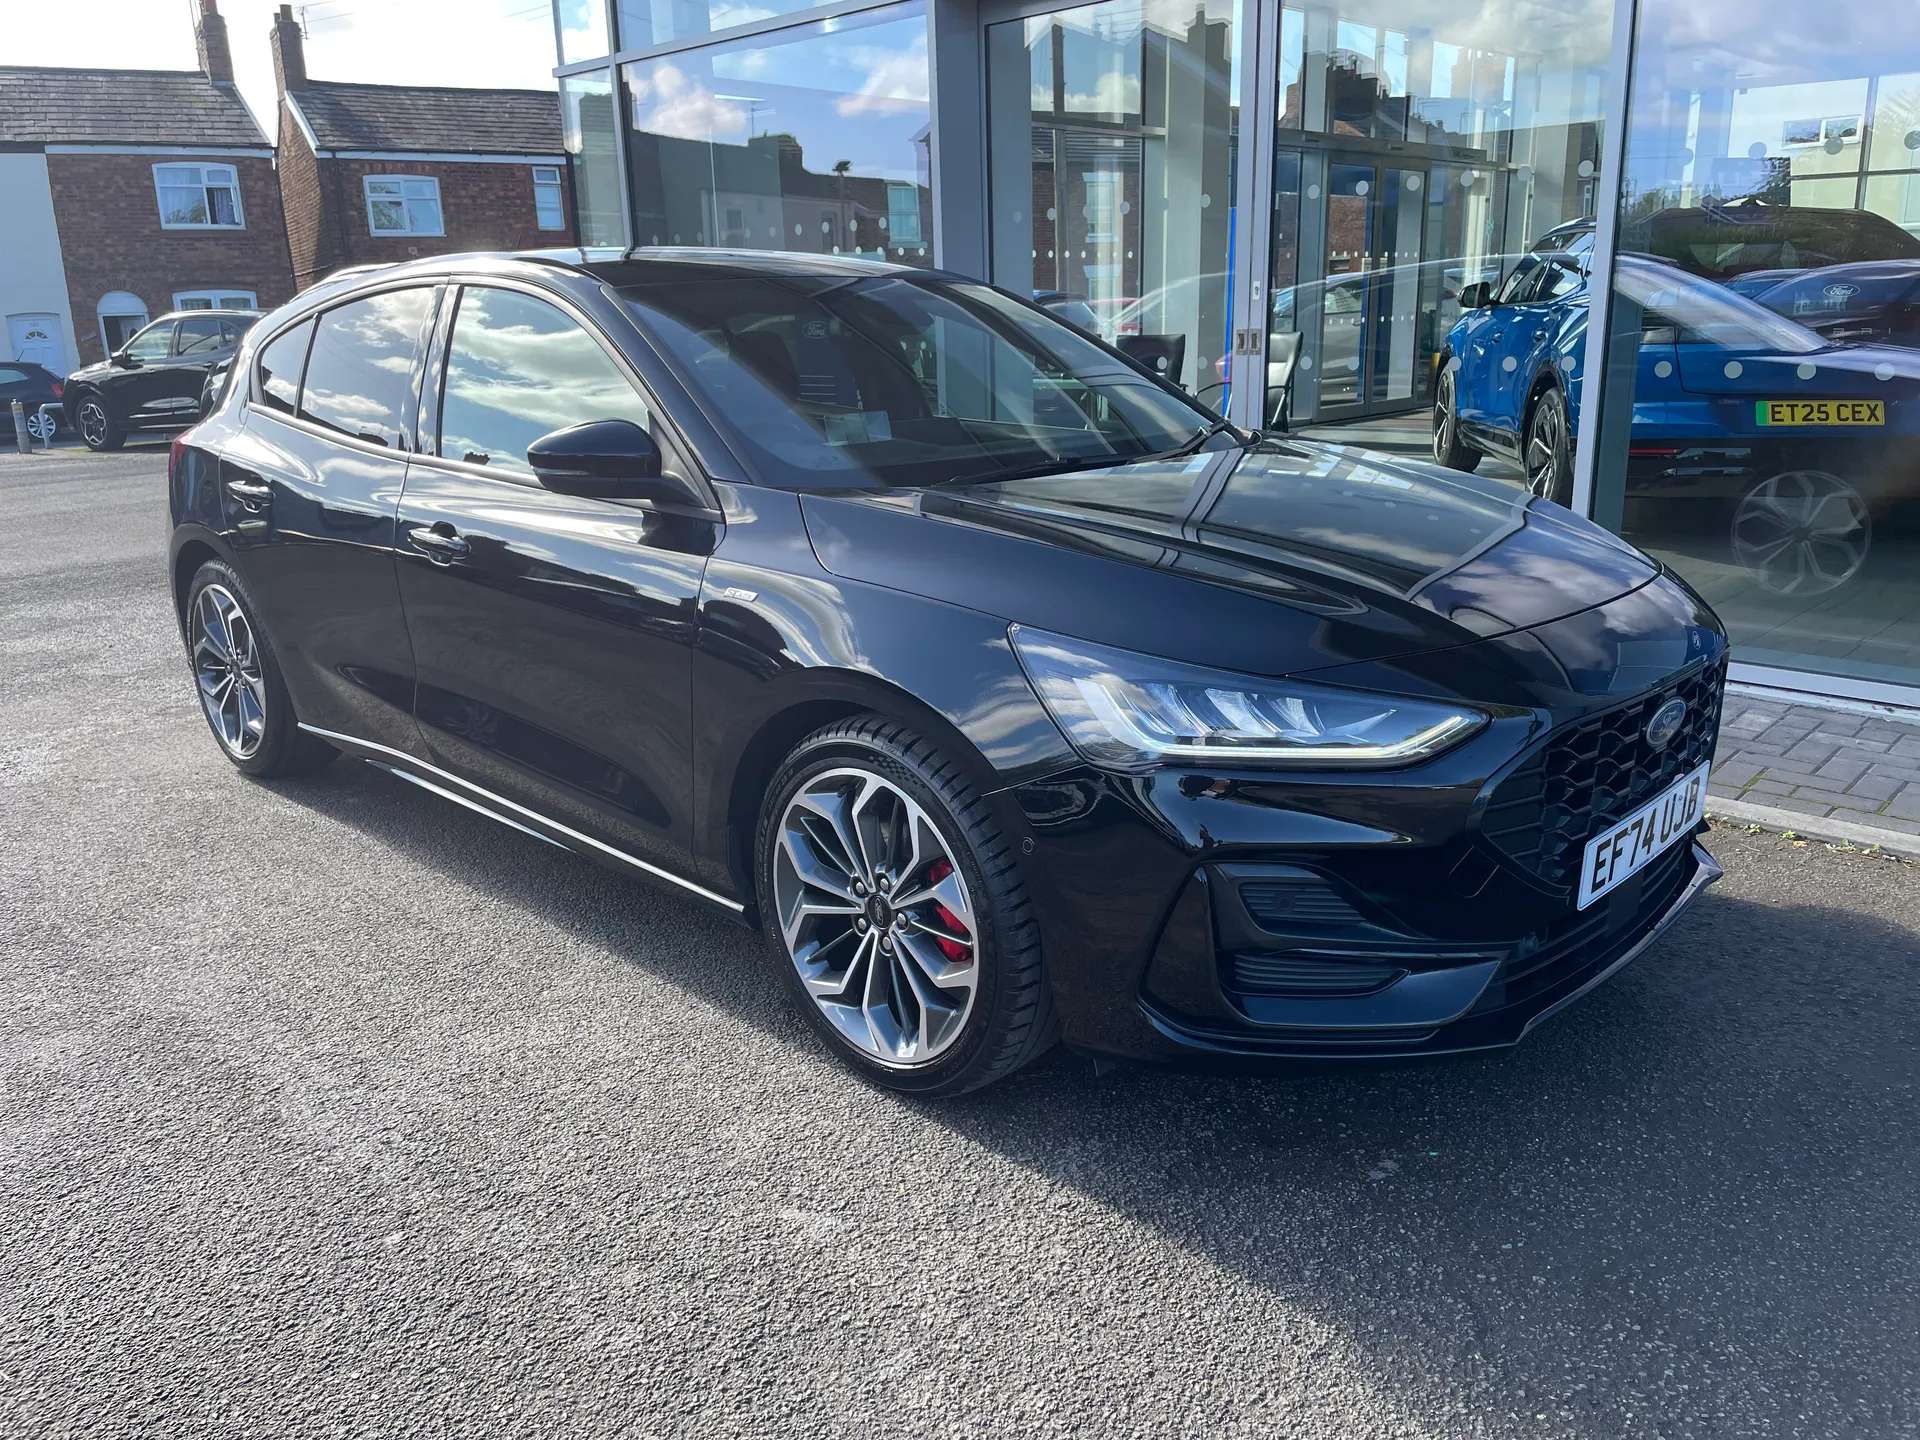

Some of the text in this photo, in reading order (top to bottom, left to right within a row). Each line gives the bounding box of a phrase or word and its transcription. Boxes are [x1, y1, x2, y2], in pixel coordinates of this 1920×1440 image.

[1771, 403, 1880, 422] ET25 CEX
[1591, 776, 1700, 894] EF74 UJB
